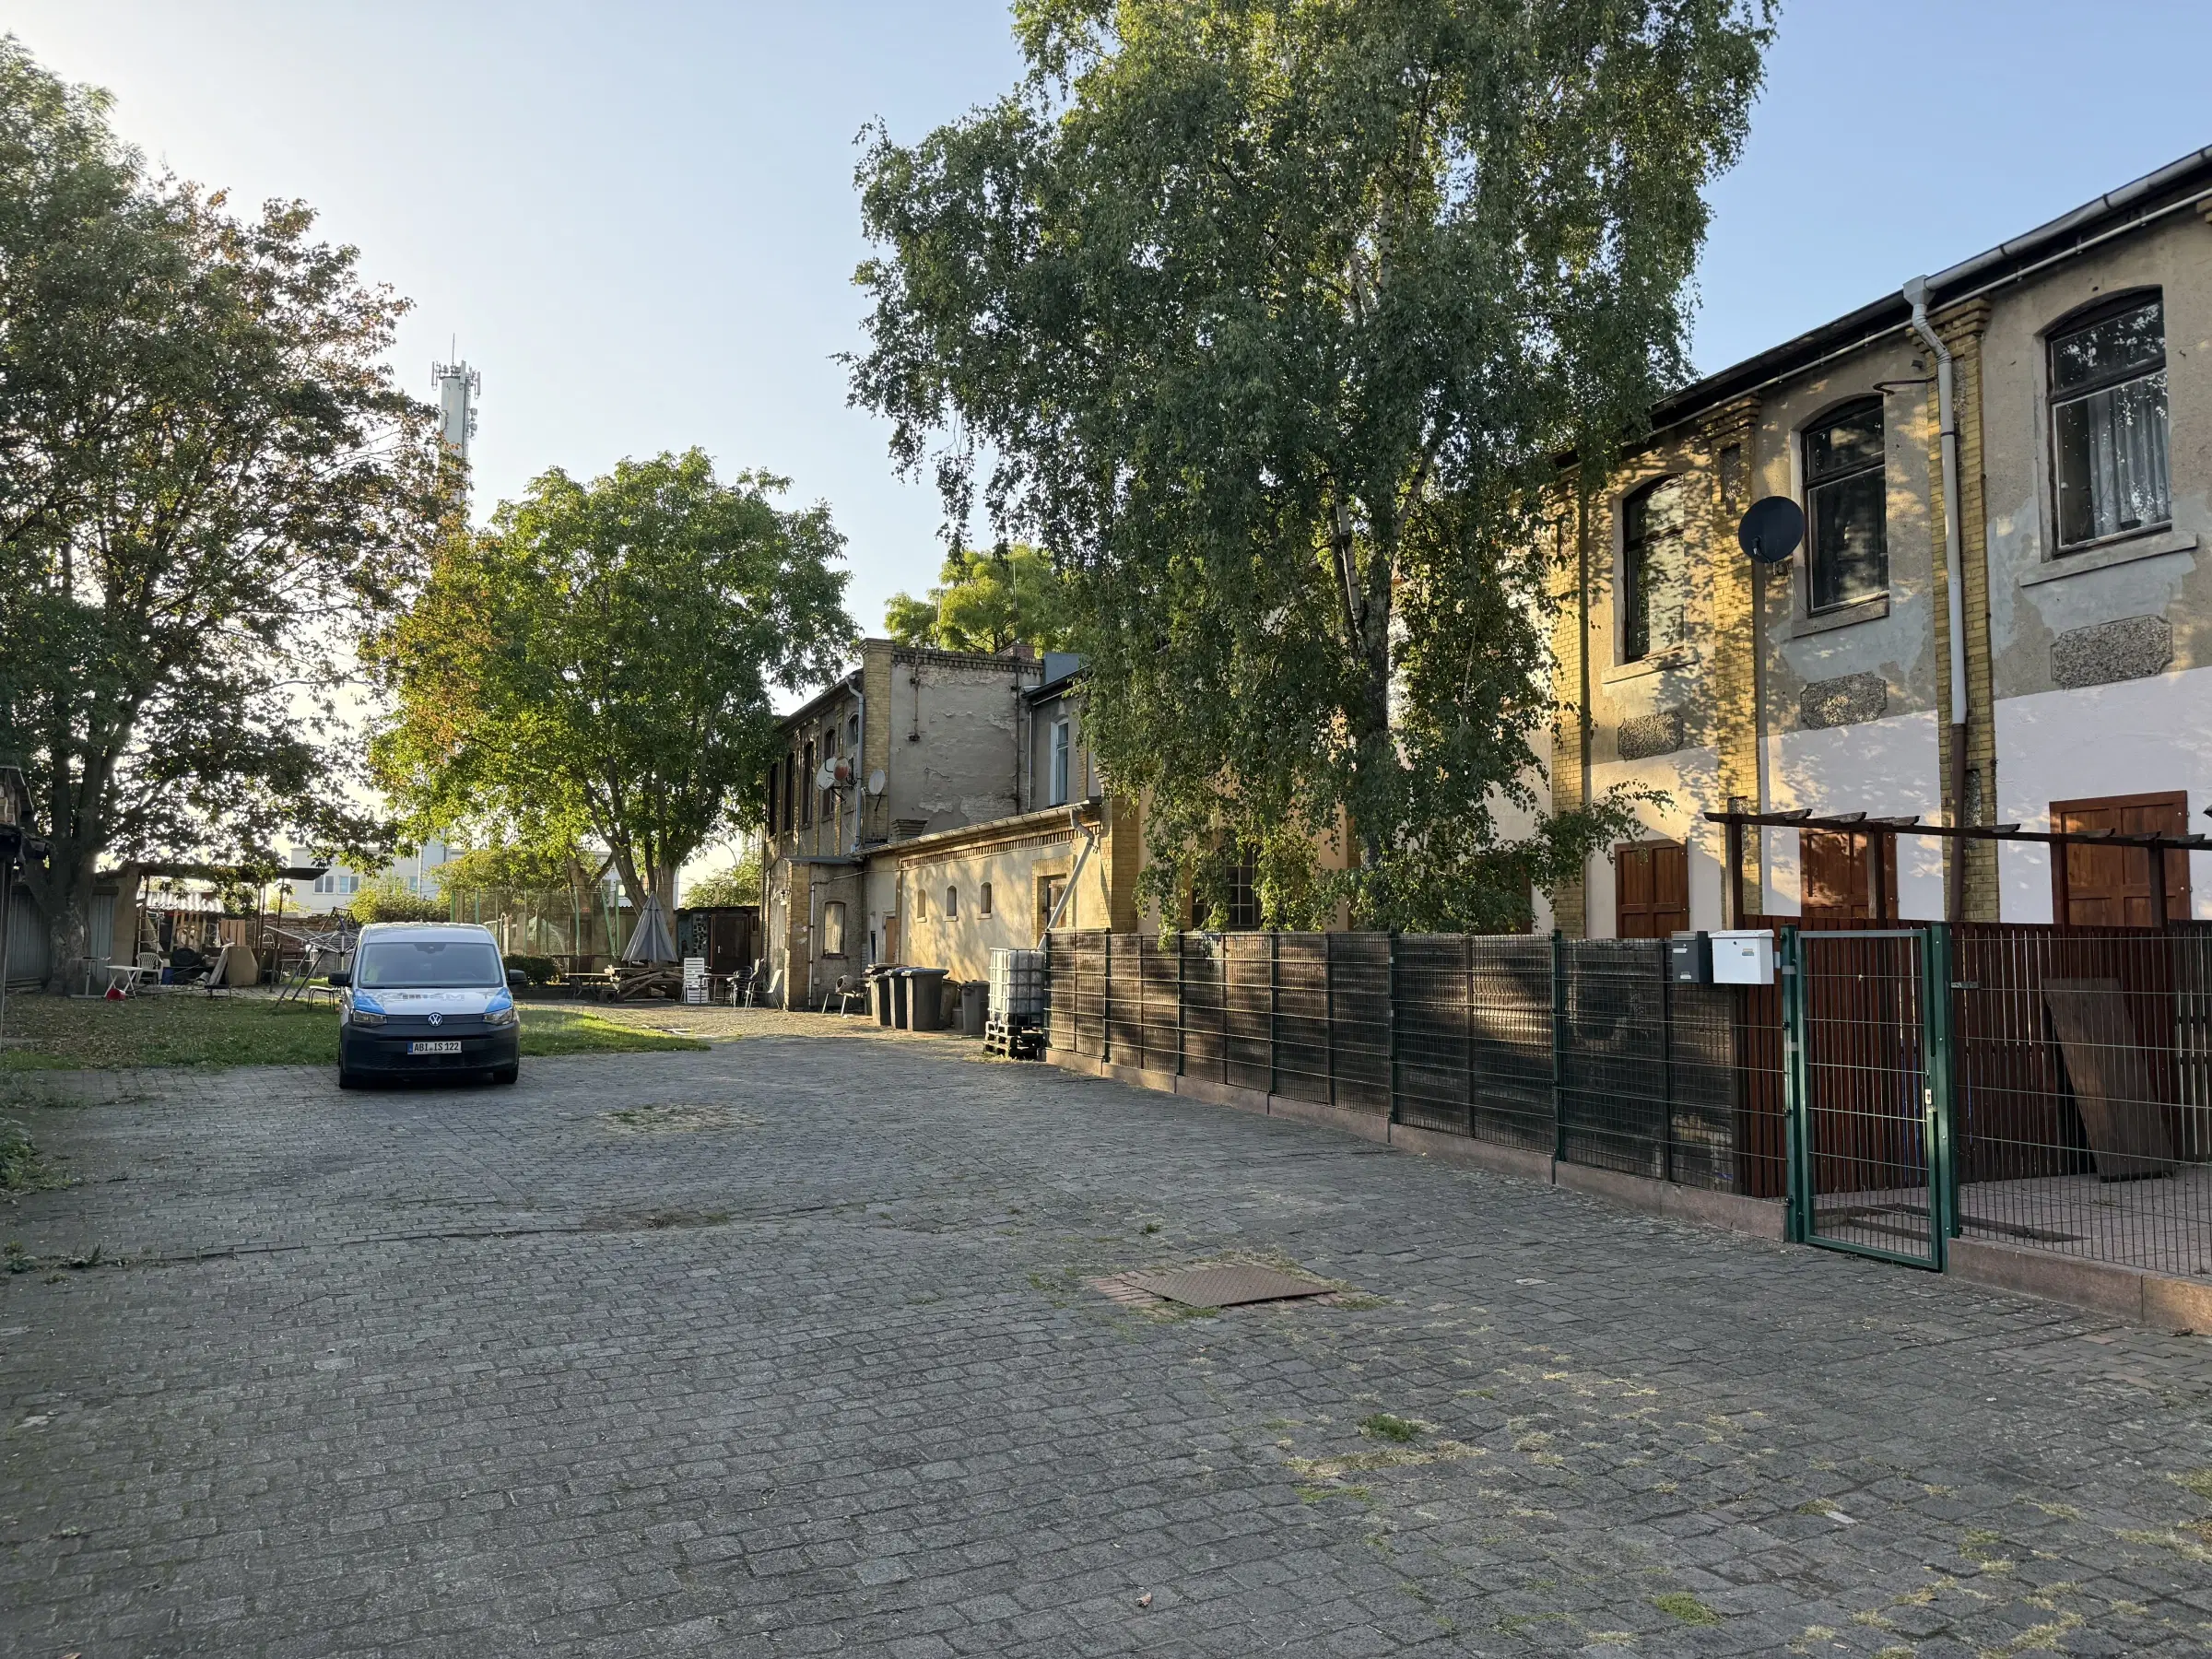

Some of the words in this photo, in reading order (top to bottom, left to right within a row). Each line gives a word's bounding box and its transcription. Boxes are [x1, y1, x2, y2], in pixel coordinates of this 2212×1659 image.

[414, 1042, 429, 1052] ABI
[433, 1042, 443, 1052] IS
[444, 1041, 459, 1051] 122
